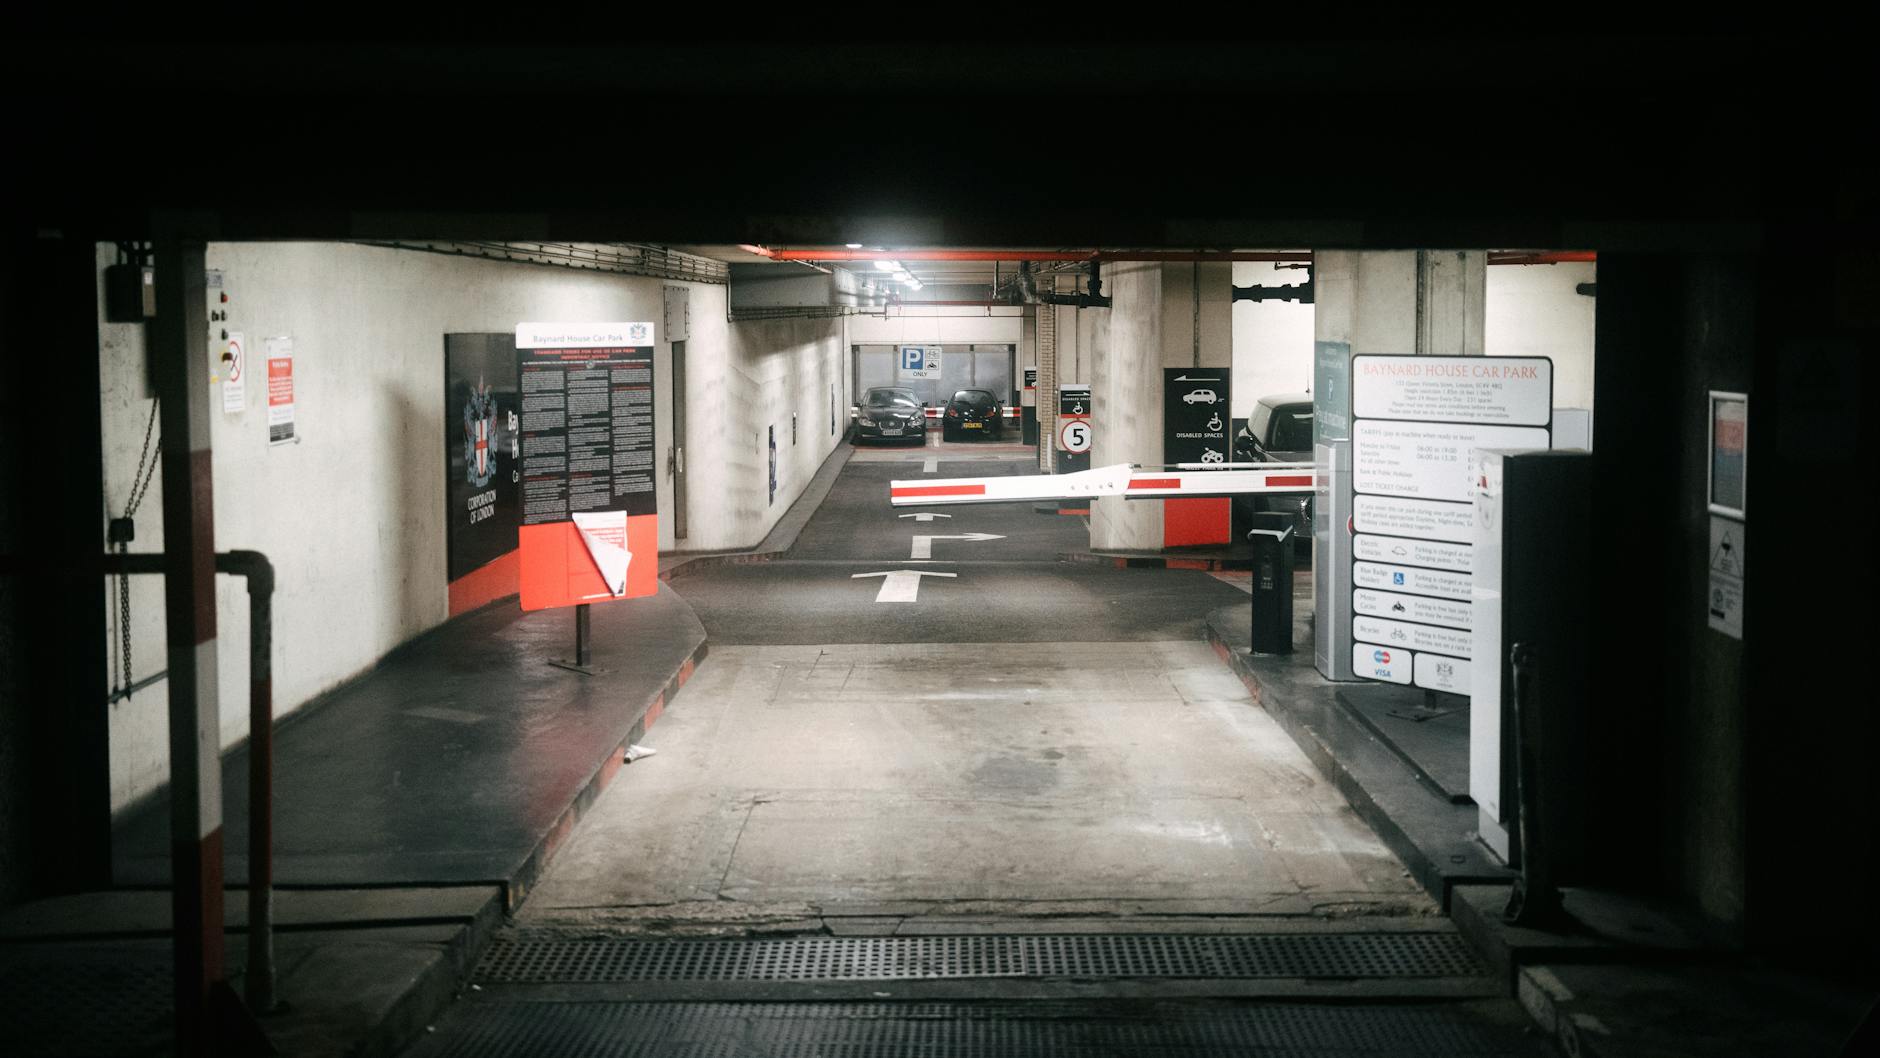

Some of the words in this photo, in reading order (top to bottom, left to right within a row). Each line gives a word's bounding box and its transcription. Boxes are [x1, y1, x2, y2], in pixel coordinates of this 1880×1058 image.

[534, 335, 565, 344] Baynard
[593, 334, 606, 342] Car
[906, 350, 921, 368] P
[1364, 364, 1421, 376] BAYNARD
[1426, 365, 1468, 377] HOUSE
[1472, 366, 1499, 378] CAR
[1503, 366, 1537, 379] PARK
[1073, 428, 1084, 446] 5
[468, 489, 497, 510] CORPORATION
[471, 510, 477, 524] OF
[477, 503, 495, 521] LONDON
[1375, 668, 1391, 678] VISA
